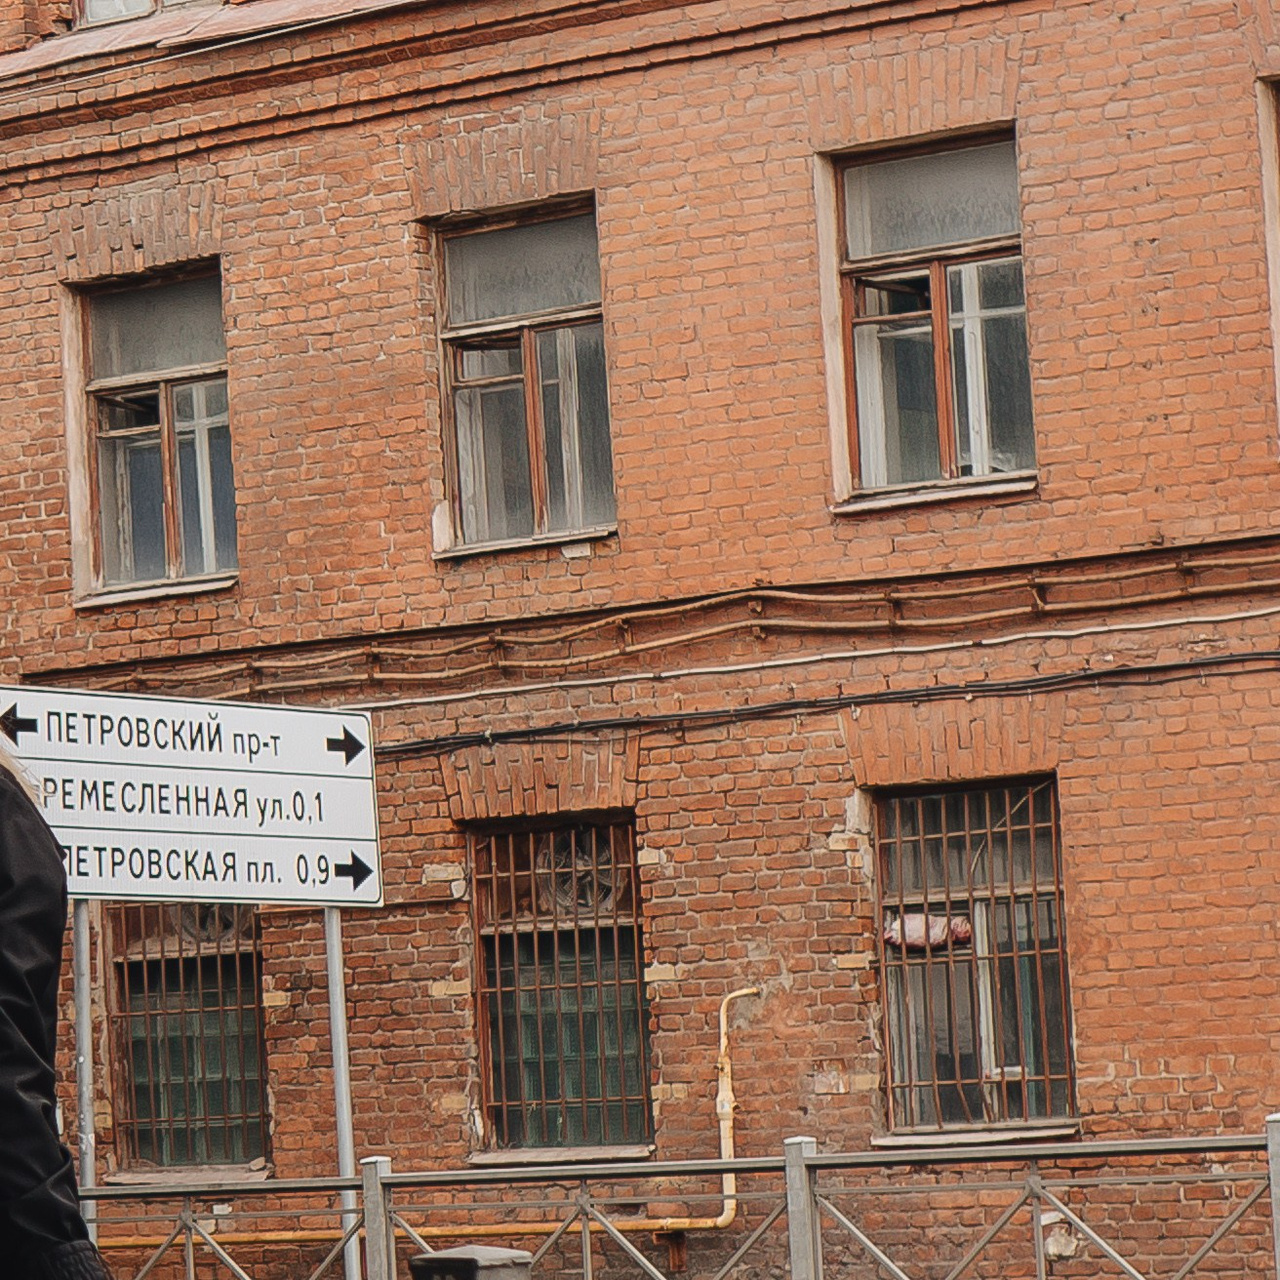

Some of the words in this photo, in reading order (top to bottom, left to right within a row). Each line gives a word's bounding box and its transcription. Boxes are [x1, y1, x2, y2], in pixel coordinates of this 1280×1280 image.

[47, 710, 222, 753] ПЕТРОВСКИЙ
[233, 734, 281, 763] пр-т
[42, 777, 248, 818] РЕМЕСЛЕННАЯ
[247, 861, 282, 884] пл.
[296, 854, 330, 888] 0,9
